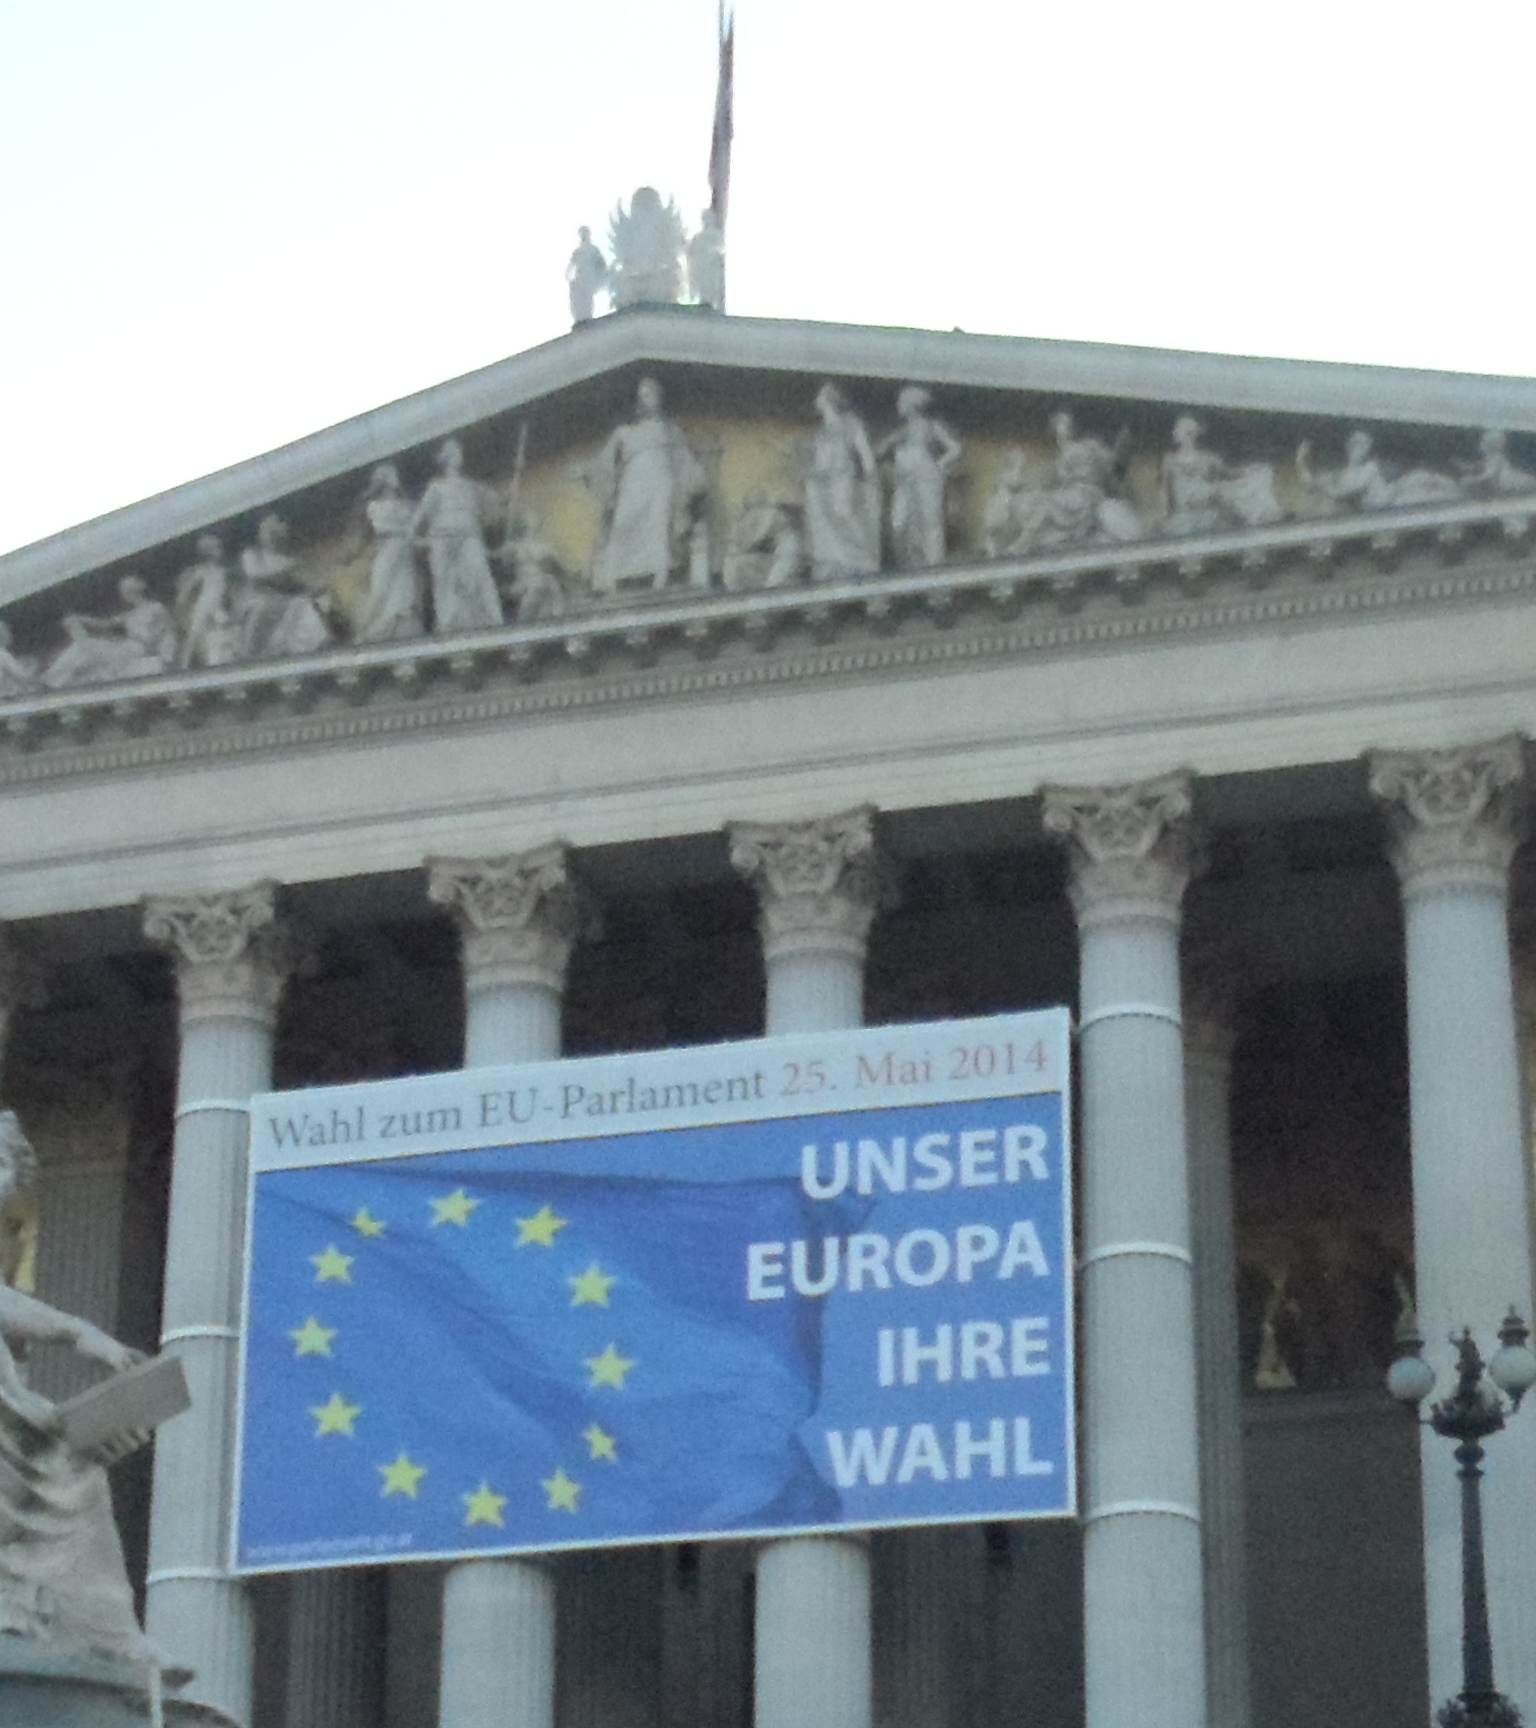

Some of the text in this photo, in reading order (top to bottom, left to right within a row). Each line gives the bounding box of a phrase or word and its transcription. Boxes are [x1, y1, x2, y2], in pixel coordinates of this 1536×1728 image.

[268, 1038, 1049, 1150] Wahl zum EU-Parlament 25. Mai 2014
[801, 1125, 1049, 1200] UNSER
[747, 1220, 1051, 1301] EUROPA
[876, 1316, 1052, 1387] IHRE
[826, 1416, 1055, 1489] WAHL
